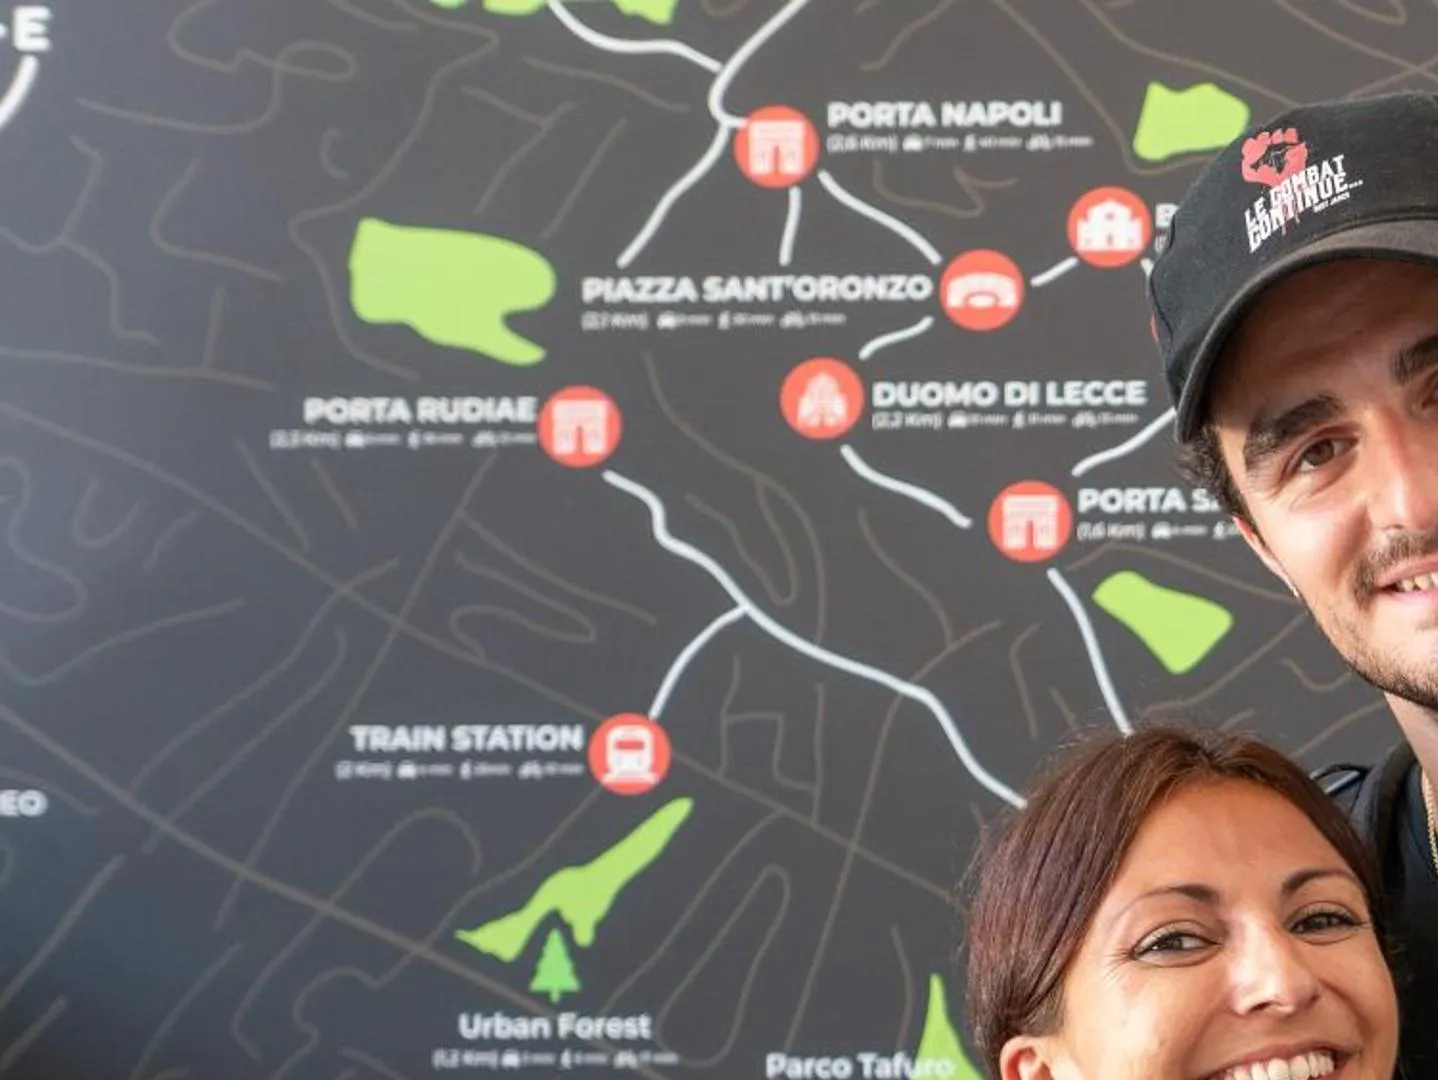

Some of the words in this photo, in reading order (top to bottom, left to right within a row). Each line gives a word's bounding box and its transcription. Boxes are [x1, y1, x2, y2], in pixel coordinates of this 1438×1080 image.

[827, 101, 936, 128] PORTA
[941, 101, 1062, 127] NAPOLI
[1269, 154, 1347, 210] COMBAT
[581, 276, 699, 302] PIAZZA
[703, 275, 934, 300] SANT'ORONZO
[872, 382, 999, 407] DUOMO
[1003, 382, 1040, 406] DI
[1046, 380, 1147, 406] LECCE
[304, 397, 411, 424] PORTA
[416, 397, 537, 423] RUDIAE
[1078, 488, 1186, 513] PORTA
[350, 725, 447, 751] TRAIN
[451, 725, 584, 751] STATION
[458, 1014, 551, 1040] Urban
[557, 1013, 652, 1040] Forest
[766, 1053, 851, 1080] Parco
[857, 1052, 954, 1080] Tafuro
